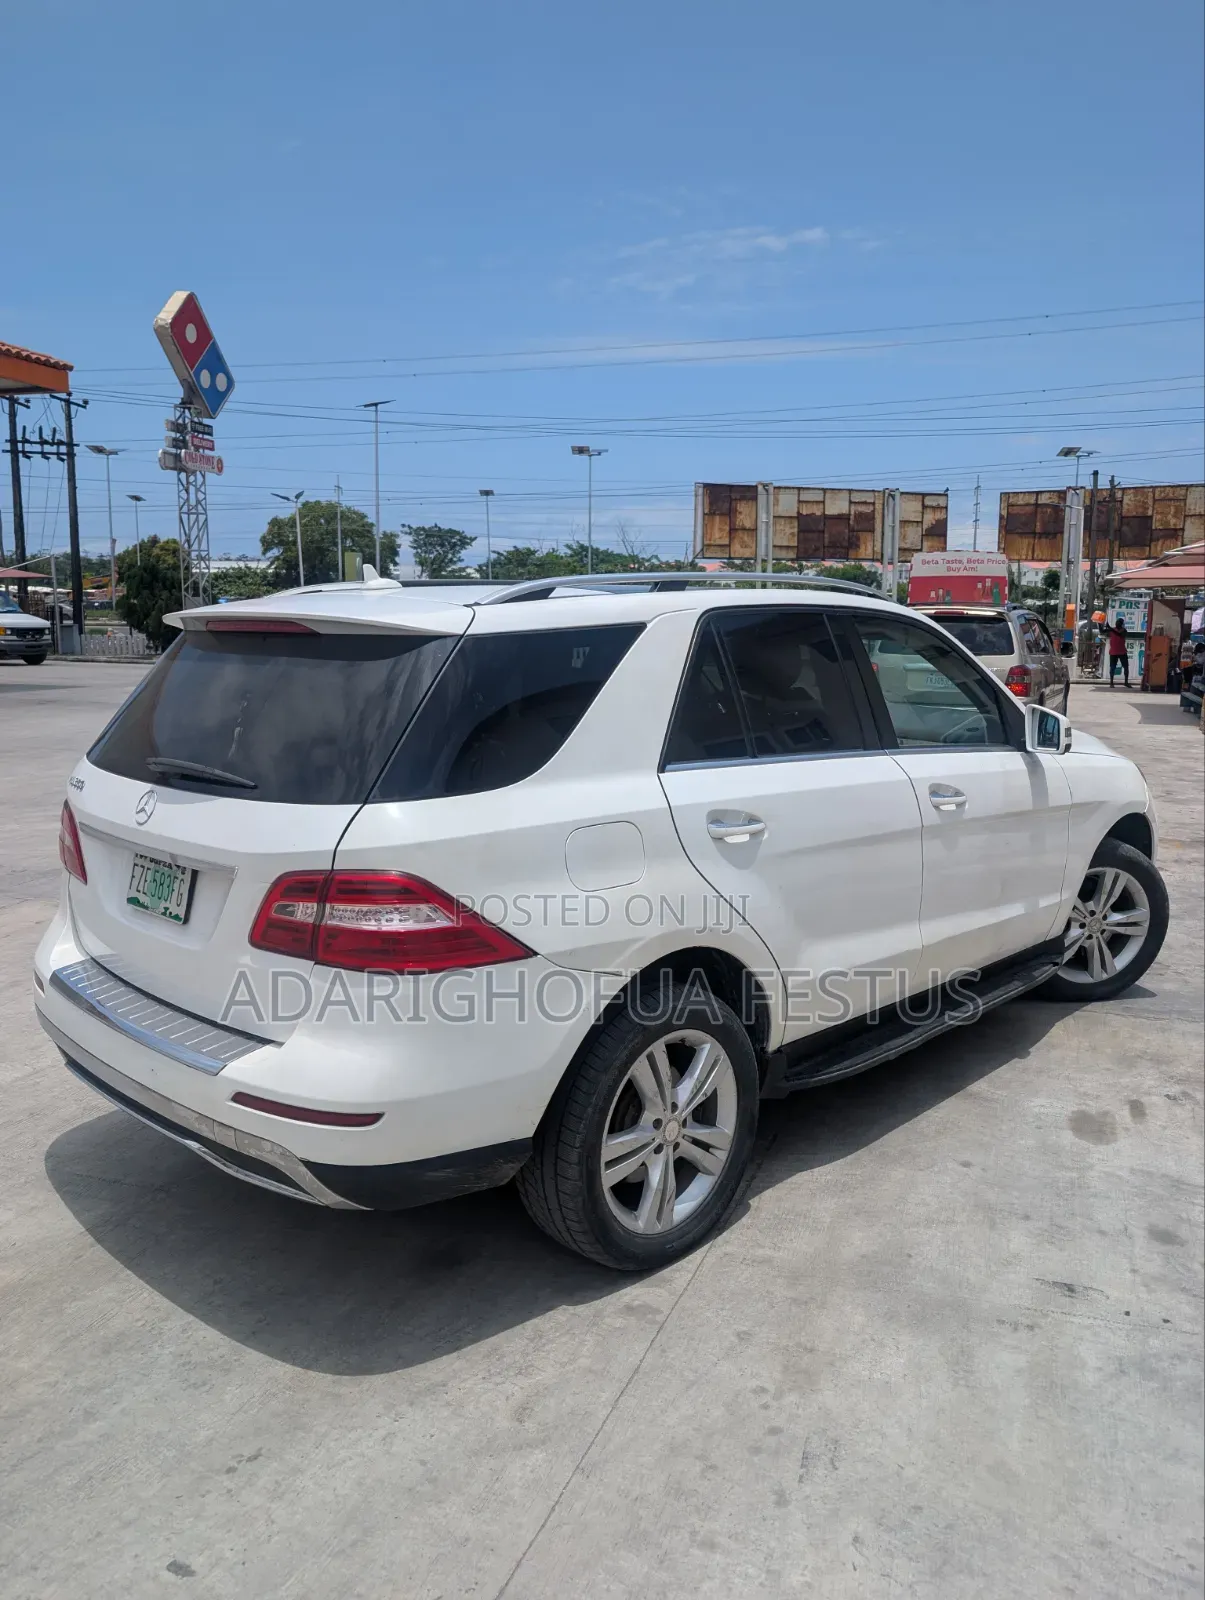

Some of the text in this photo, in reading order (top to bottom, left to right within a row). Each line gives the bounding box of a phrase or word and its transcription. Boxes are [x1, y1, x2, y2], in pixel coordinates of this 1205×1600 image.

[941, 558, 964, 566] Taste,
[966, 557, 985, 565] Beta
[946, 565, 960, 573] Buy
